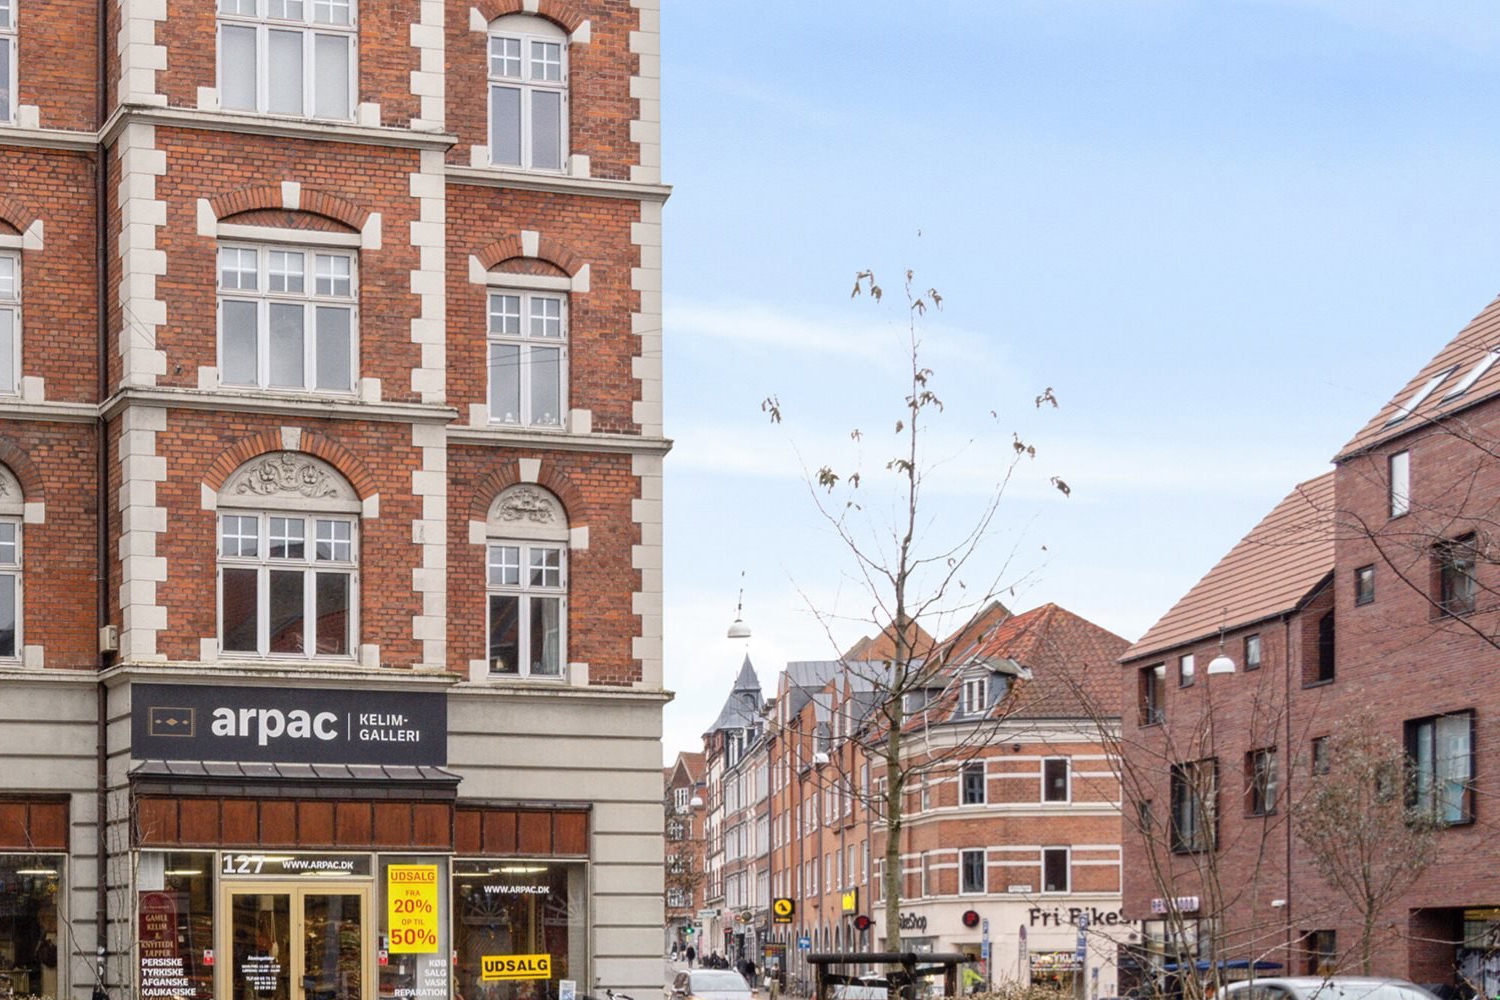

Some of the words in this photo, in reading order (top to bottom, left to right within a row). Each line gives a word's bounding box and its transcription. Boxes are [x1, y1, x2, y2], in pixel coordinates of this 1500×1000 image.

[359, 713, 409, 726] KELIM-
[211, 706, 338, 746] arpac
[359, 729, 420, 742] GALLERI
[223, 855, 266, 874] 127
[282, 860, 354, 870] WWW.ARPAC.DK
[390, 871, 436, 881] UDSALG
[405, 889, 421, 897] FRA
[483, 885, 550, 894] WWW.ARPAC.DK
[393, 898, 432, 914] 20%
[1028, 906, 1061, 927] Fri
[401, 918, 413, 926] OP
[414, 918, 425, 926] TIL
[390, 928, 437, 945] 50%
[141, 958, 183, 967] PERSISKE
[484, 959, 548, 972] UDSALG
[141, 968, 184, 976] TYRKISKE
[424, 969, 447, 977] SALG
[141, 978, 189, 986] AFGANSKE
[424, 978, 447, 987] VASK
[141, 988, 197, 996] KAUKASISKE
[394, 988, 447, 997] REPARATION
